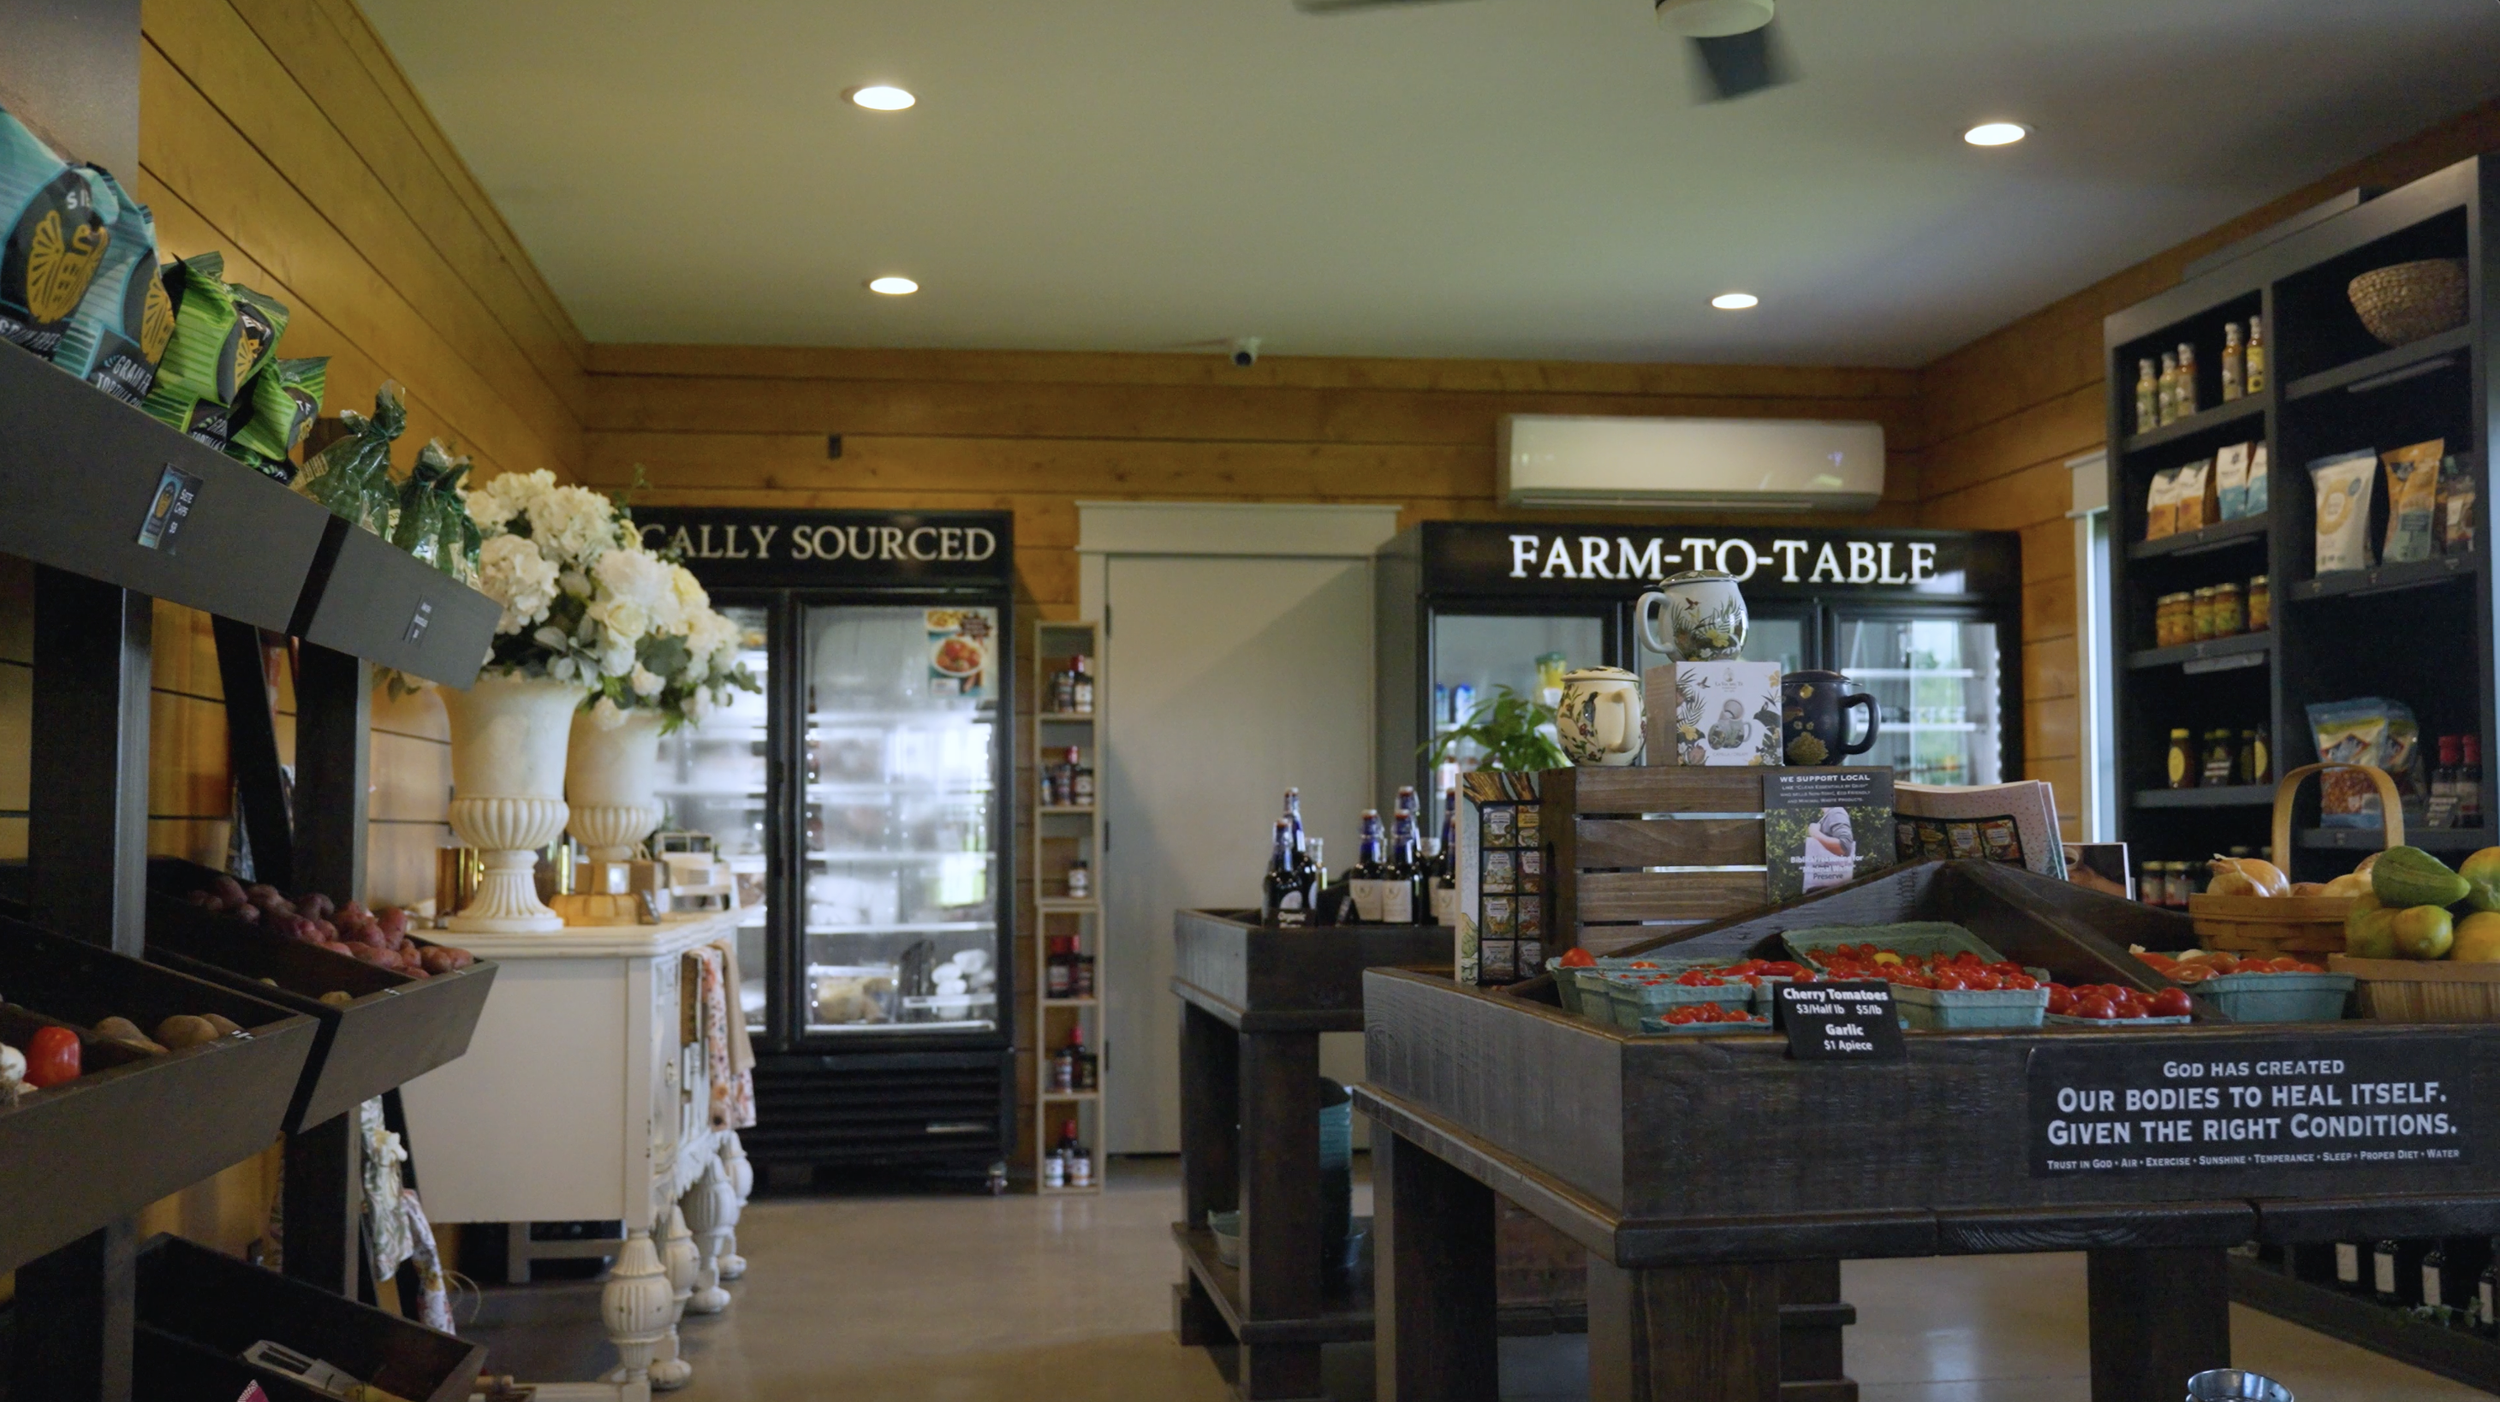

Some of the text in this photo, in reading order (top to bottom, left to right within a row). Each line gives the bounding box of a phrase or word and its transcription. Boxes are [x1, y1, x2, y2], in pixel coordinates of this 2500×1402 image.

[112, 354, 145, 387] GRAIN
[791, 524, 996, 562] SOURCED
[1508, 534, 1938, 585] FARM-TO-TABLE
[1782, 988, 1888, 1002] Cherry Tomatoes
[1796, 1004, 1883, 1015] $3/Half lb $5/lb
[1825, 1024, 1864, 1036] Garlic
[1824, 1040, 1873, 1052] $1 Apiece
[2163, 1059, 2345, 1078] GOD HAS CREATED
[2057, 1081, 2447, 1113] OUR BODIES TO HEAL ITSELF.
[2047, 1112, 2457, 1146] GIVEN THE RIGHT CONDITIONS.
[2047, 1149, 2460, 1170] TRUST IN GOD AIR EXERCISE SUNSHINE TEMPERANCE SLEEP PROPER DIET WATER
